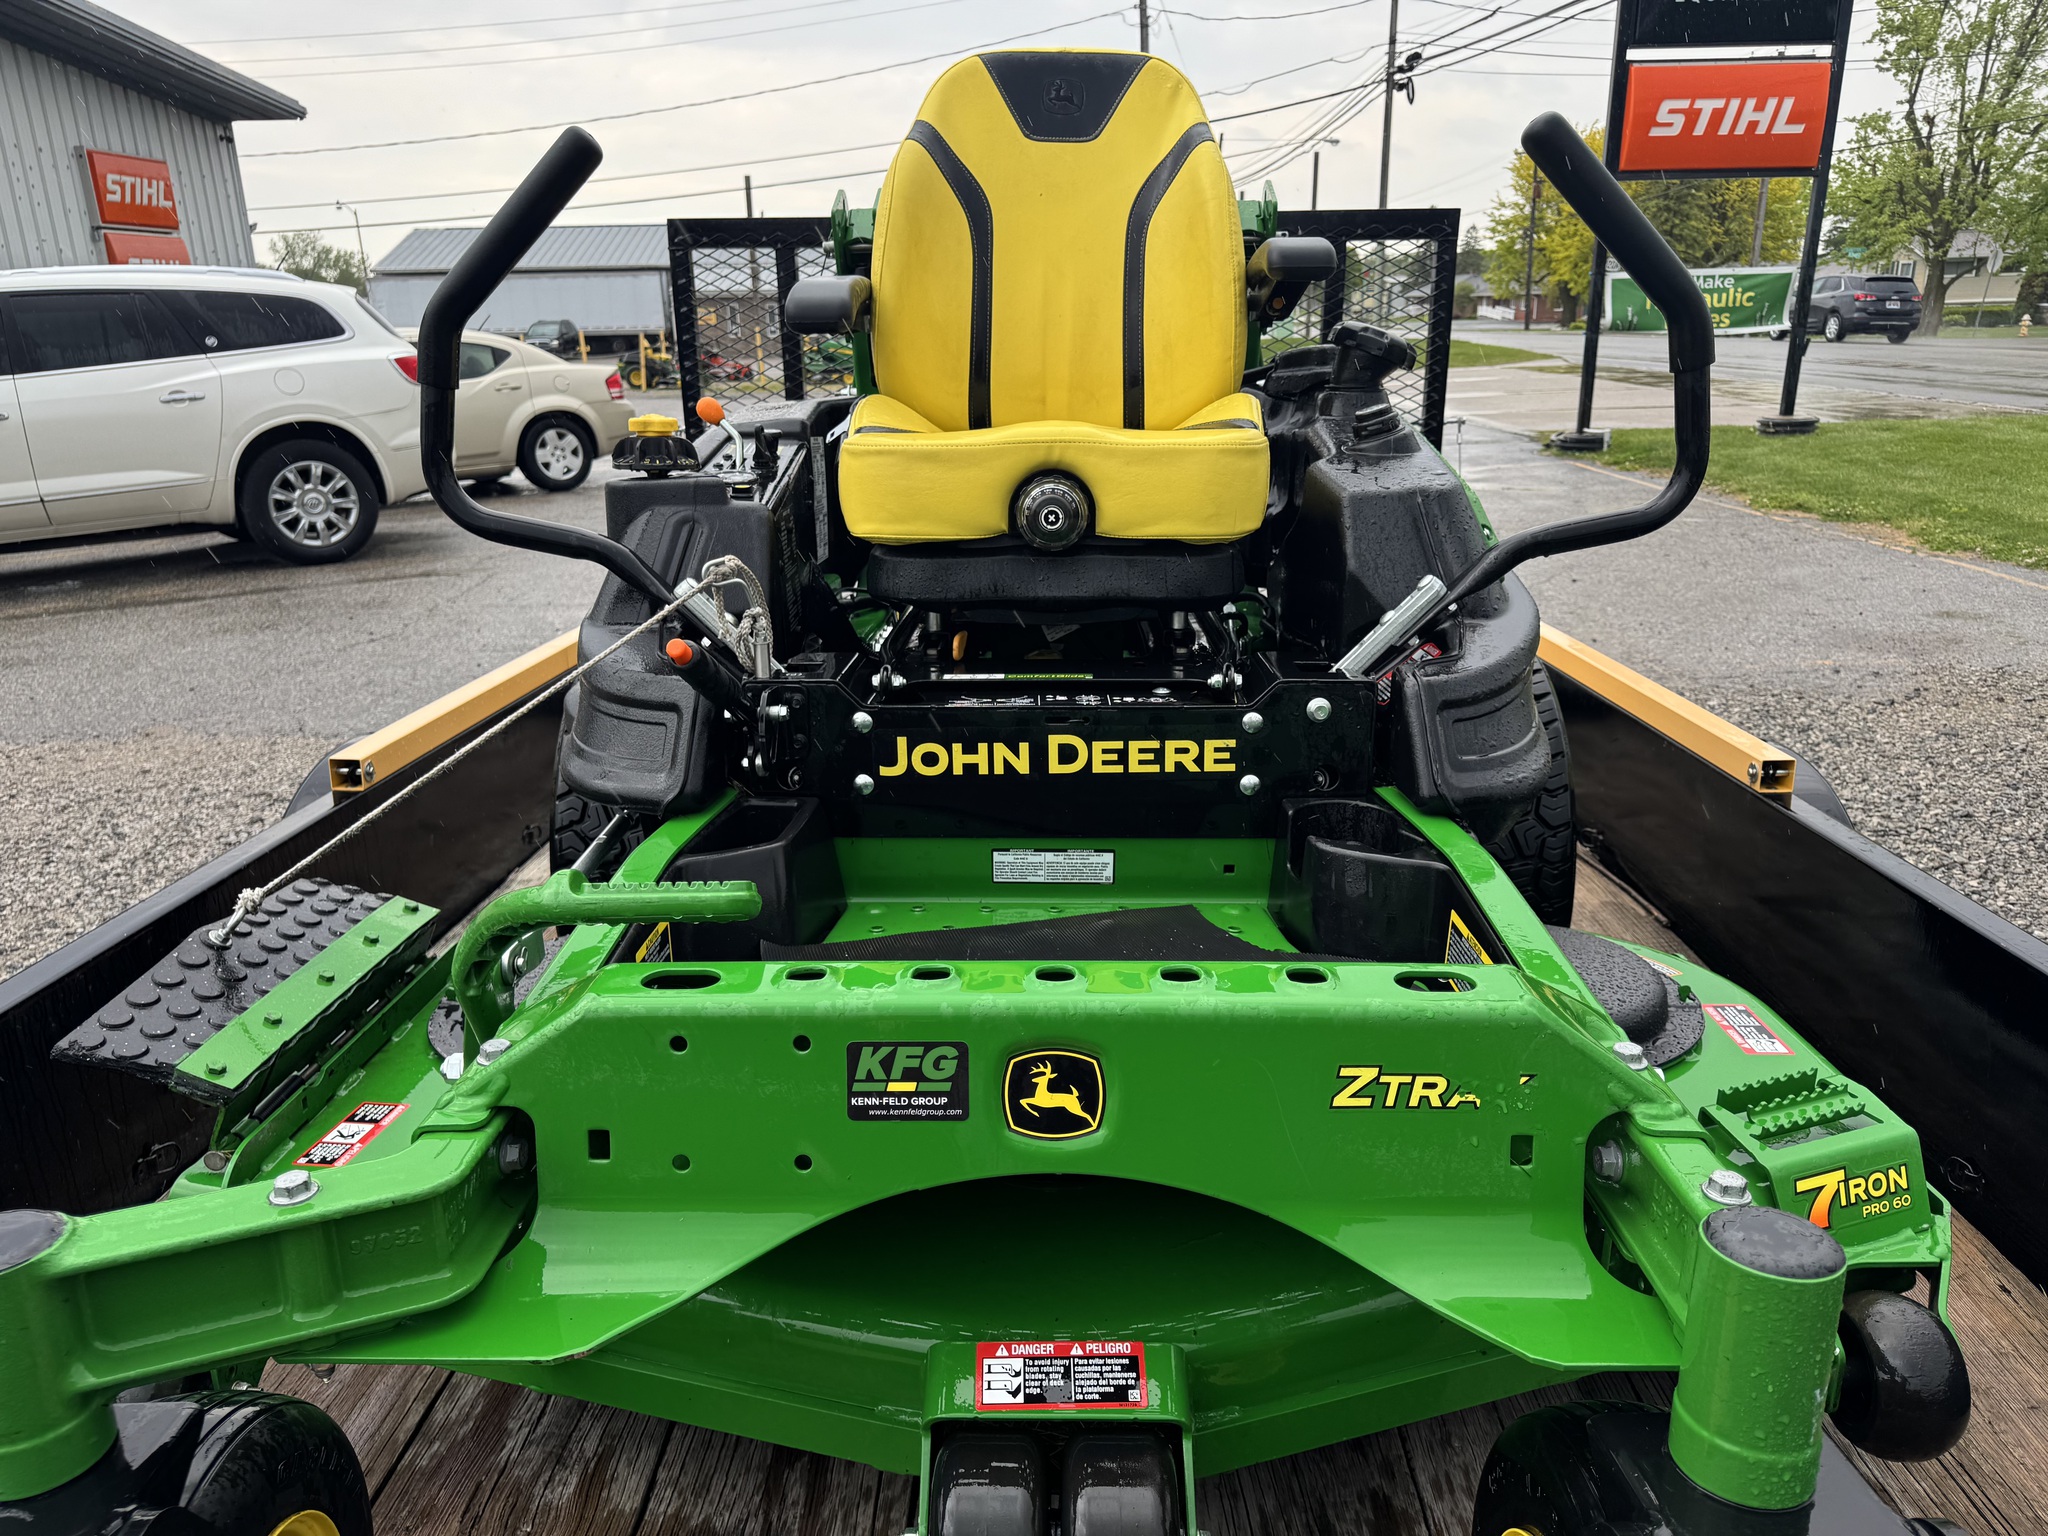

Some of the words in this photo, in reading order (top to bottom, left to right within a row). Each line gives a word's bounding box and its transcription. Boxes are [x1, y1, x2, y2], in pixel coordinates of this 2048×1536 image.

[1648, 96, 1806, 136] STIHL
[106, 173, 173, 208] STIHL
[879, 736, 1030, 777] JOHN
[1048, 734, 1236, 774] DEERE
[854, 1045, 960, 1081] KFG
[851, 1097, 908, 1106] KENN-FELD
[910, 1097, 948, 1106] GROUP
[868, 1108, 963, 1117] www.kennfeldgroup.com
[1862, 1201, 1890, 1218] PRO
[1893, 1194, 1911, 1209] 60
[1011, 1344, 1054, 1355] DANGER
[1086, 1342, 1131, 1354] PELIGRO
[1034, 1358, 1050, 1366] avoid
[1052, 1358, 1069, 1367] injury
[1075, 1357, 1088, 1365] Para
[1025, 1365, 1039, 1373] from
[1041, 1365, 1064, 1374] rotating
[1050, 1372, 1062, 1380] stay
[1025, 1379, 1041, 1387] clear
[1042, 1379, 1049, 1387] of
[1075, 1379, 1098, 1387] alejado
[1025, 1387, 1043, 1395] edge.
[1083, 1386, 1115, 1394] plataforma
